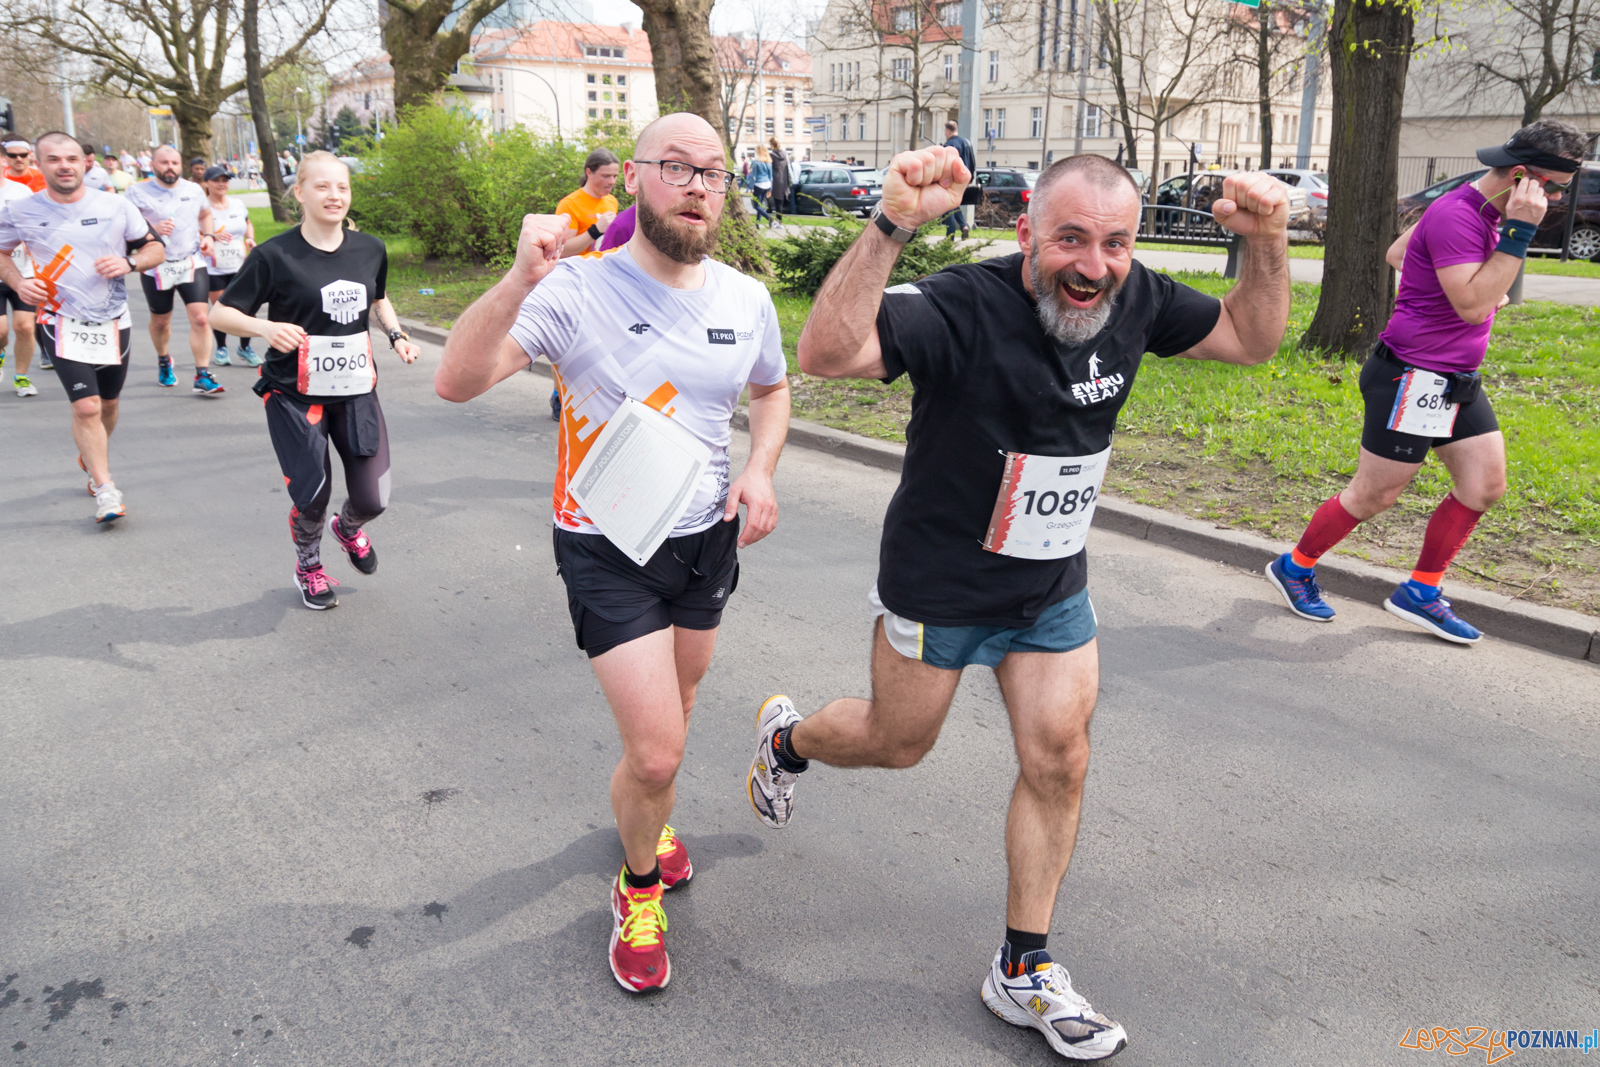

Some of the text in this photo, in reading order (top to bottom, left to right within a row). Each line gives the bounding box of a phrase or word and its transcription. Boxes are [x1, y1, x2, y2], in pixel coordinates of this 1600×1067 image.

[328, 289, 361, 298] RAGE
[332, 296, 358, 304] RUN
[628, 323, 651, 335] 4F
[70, 331, 108, 346] 7933
[312, 353, 367, 372] 10960
[1046, 519, 1083, 530] Grzegorz
